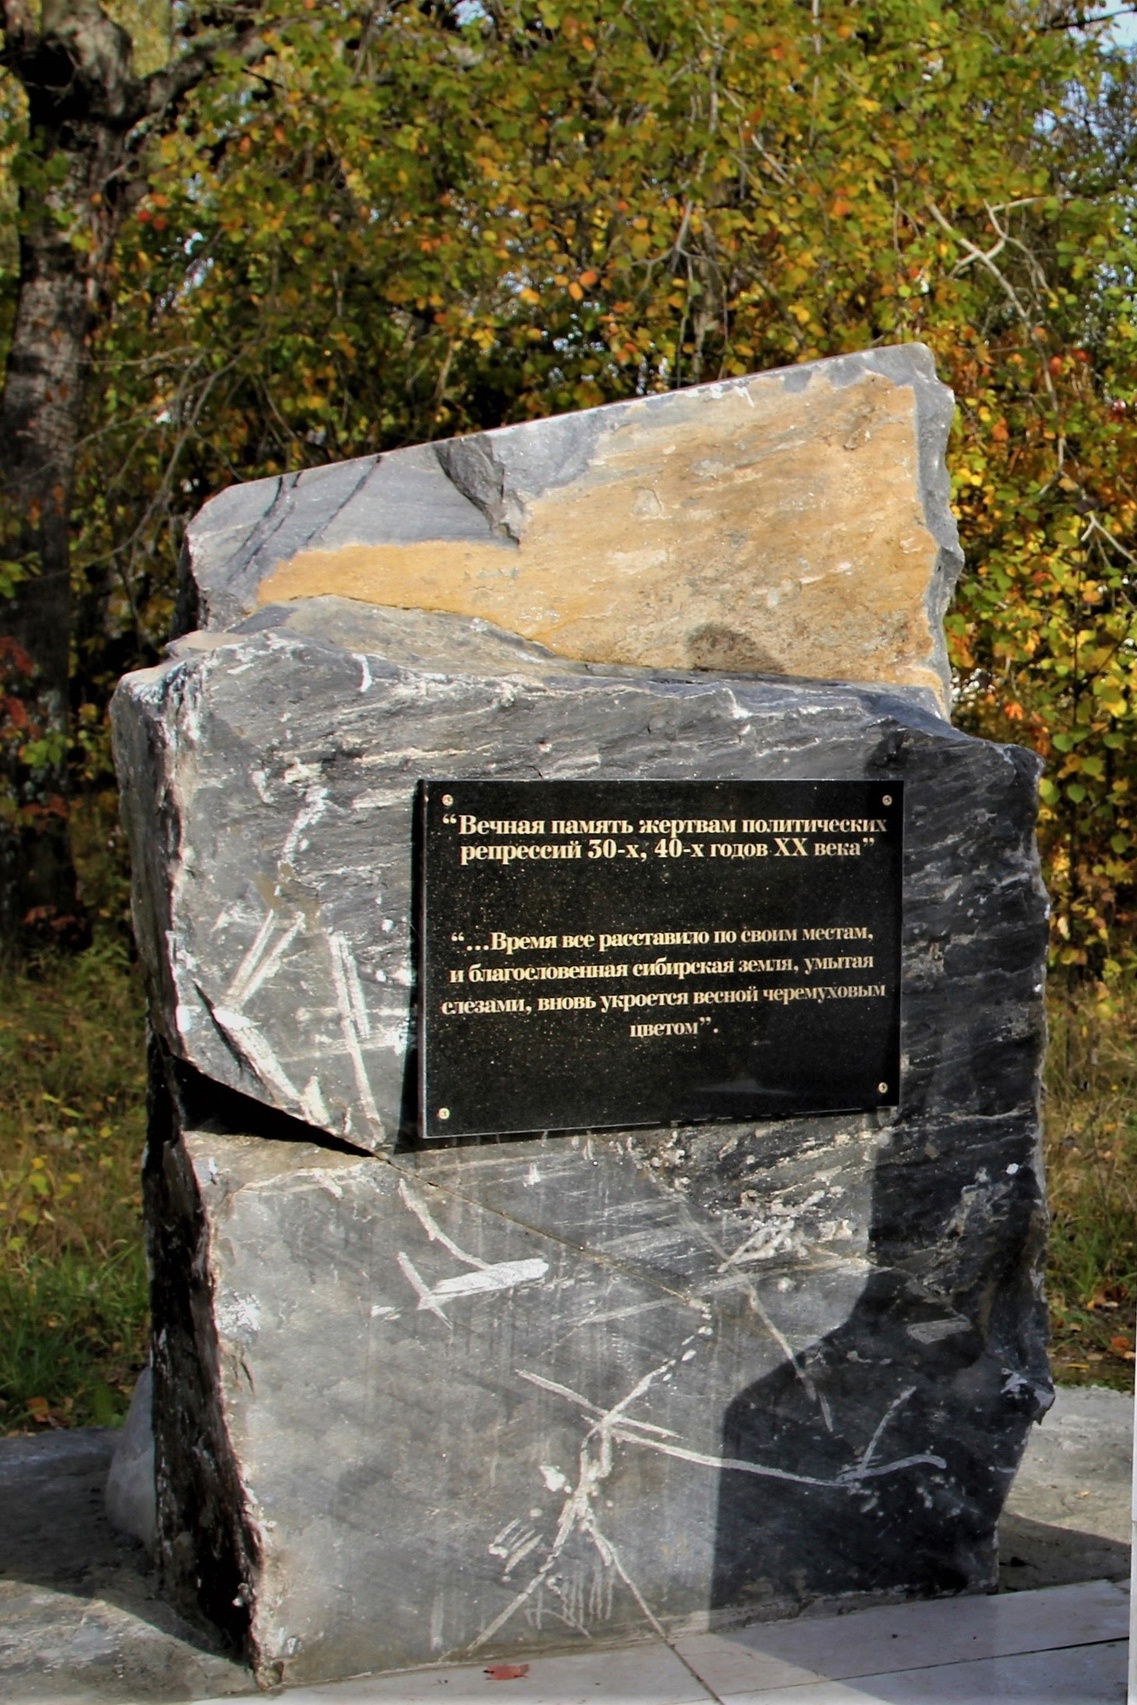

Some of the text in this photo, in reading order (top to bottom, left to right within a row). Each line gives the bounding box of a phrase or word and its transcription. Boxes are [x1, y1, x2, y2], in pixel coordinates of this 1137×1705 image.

[551, 819, 634, 834] память
[639, 819, 736, 839] жертвам
[742, 819, 887, 833] политических
[460, 840, 582, 866] репрессий
[710, 843, 768, 860] годов
[562, 934, 594, 948] все
[599, 931, 709, 951] расставило
[714, 930, 736, 944] по
[741, 929, 798, 943] своим
[802, 927, 874, 942] местам,
[449, 956, 874, 983] и благословенная сибирская земля, умытая
[441, 984, 886, 1015] слезами, вновь укроется весной черемуховым
